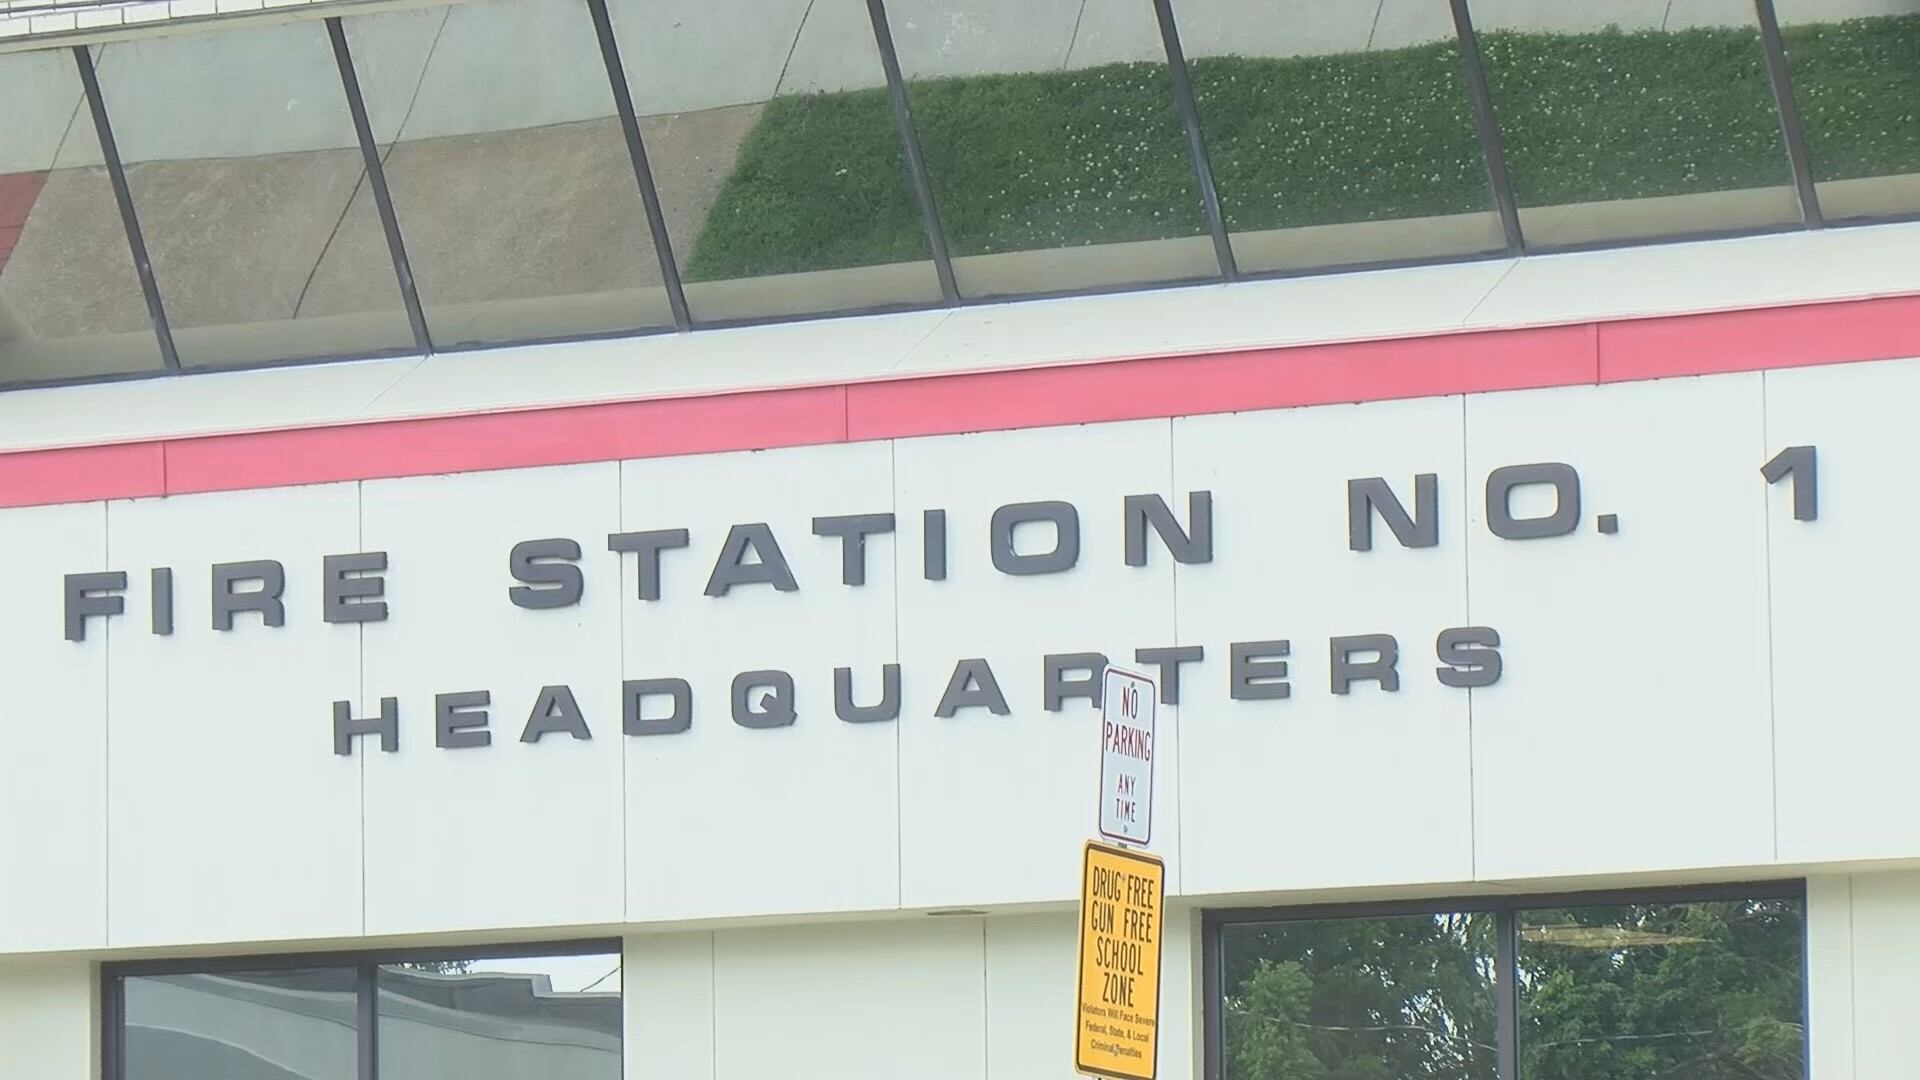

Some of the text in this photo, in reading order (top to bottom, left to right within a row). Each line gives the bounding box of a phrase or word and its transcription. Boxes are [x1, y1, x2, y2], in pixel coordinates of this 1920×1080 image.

[64, 445, 1818, 642] FIRE STATION NO. 1
[333, 626, 1502, 756] HEADQUARTERS
[1122, 686, 1138, 719] NO
[1105, 721, 1151, 762] PARKING
[1117, 773, 1136, 797] ANY
[1116, 798, 1136, 823] TIME
[1092, 865, 1155, 910] DRUG FREE
[1091, 900, 1153, 944] GUN FREE
[1096, 936, 1144, 976] SCHOOL
[1102, 972, 1135, 1008] ZONE
[1119, 1010, 1134, 1023] Face
[1132, 1031, 1150, 1043] Local
